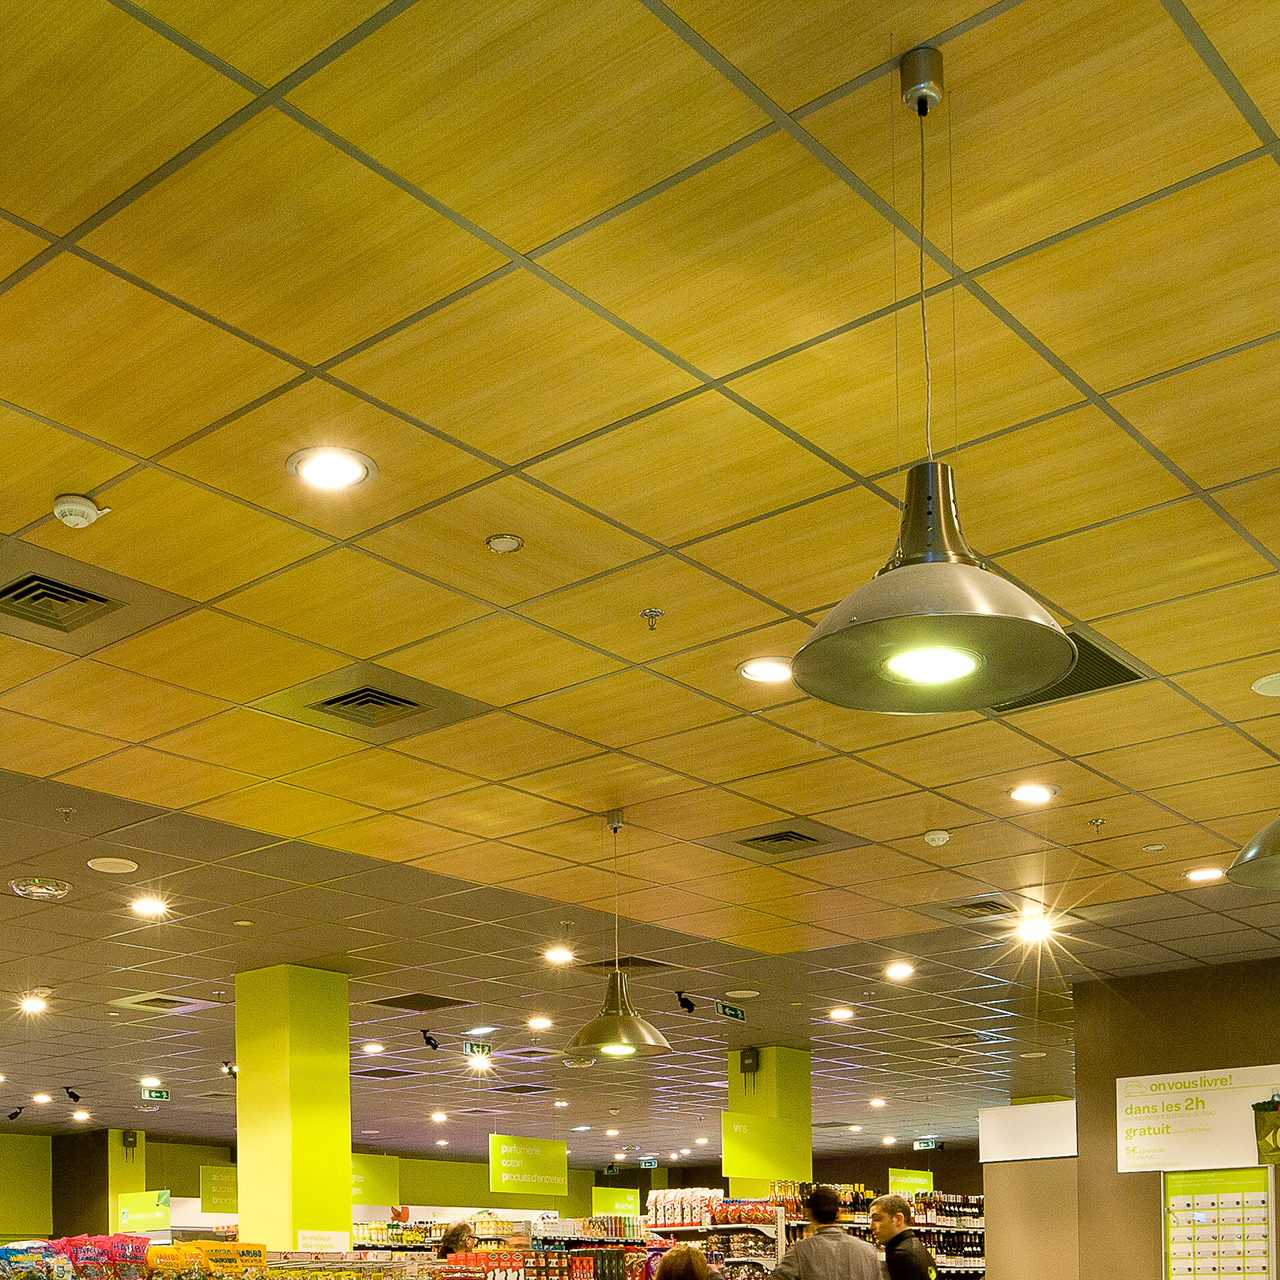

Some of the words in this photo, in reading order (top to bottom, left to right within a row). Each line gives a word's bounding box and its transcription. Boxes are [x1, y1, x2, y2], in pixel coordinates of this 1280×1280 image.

[1149, 1082, 1166, 1092] on
[1167, 1080, 1198, 1091] vous
[1200, 1075, 1233, 1088] livre!
[1125, 1103, 1158, 1116] dans
[1162, 1101, 1181, 1113] les
[1184, 1097, 1206, 1111] 2h
[1125, 1123, 1170, 1140] gratuit
[501, 1144, 540, 1155] parfumerie
[501, 1158, 522, 1168] coton
[502, 1172, 531, 1183] produits
